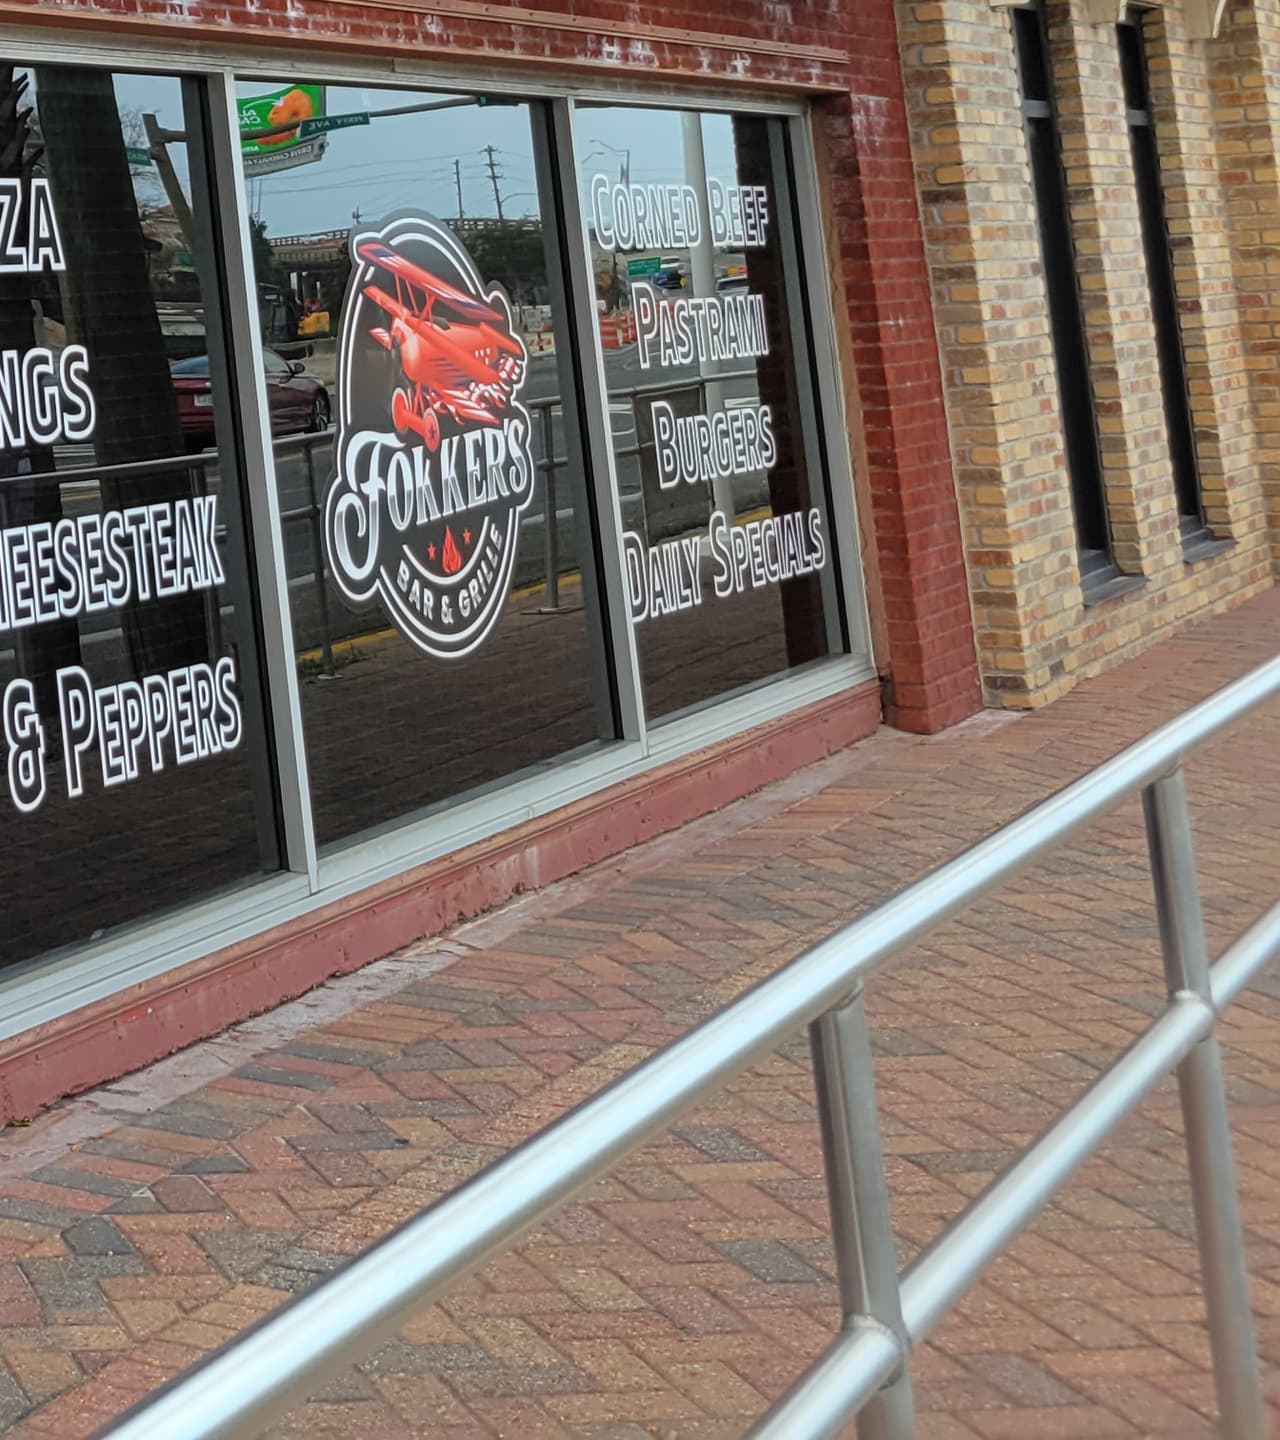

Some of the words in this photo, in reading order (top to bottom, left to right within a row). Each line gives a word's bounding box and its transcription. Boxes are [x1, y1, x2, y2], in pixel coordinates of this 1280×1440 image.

[591, 173, 702, 250] CORNED
[705, 176, 770, 247] BEEF
[631, 282, 770, 369] PASTRAMI
[650, 400, 777, 490] BURGERS
[334, 418, 528, 581] FOKKER'S
[397, 559, 433, 621] BAR
[441, 593, 454, 624] &
[458, 523, 503, 617] GRILLE
[622, 531, 703, 624] DAILY
[709, 508, 826, 598] SPECIALS
[3, 678, 45, 813] &
[56, 657, 243, 799] PEPPERS
